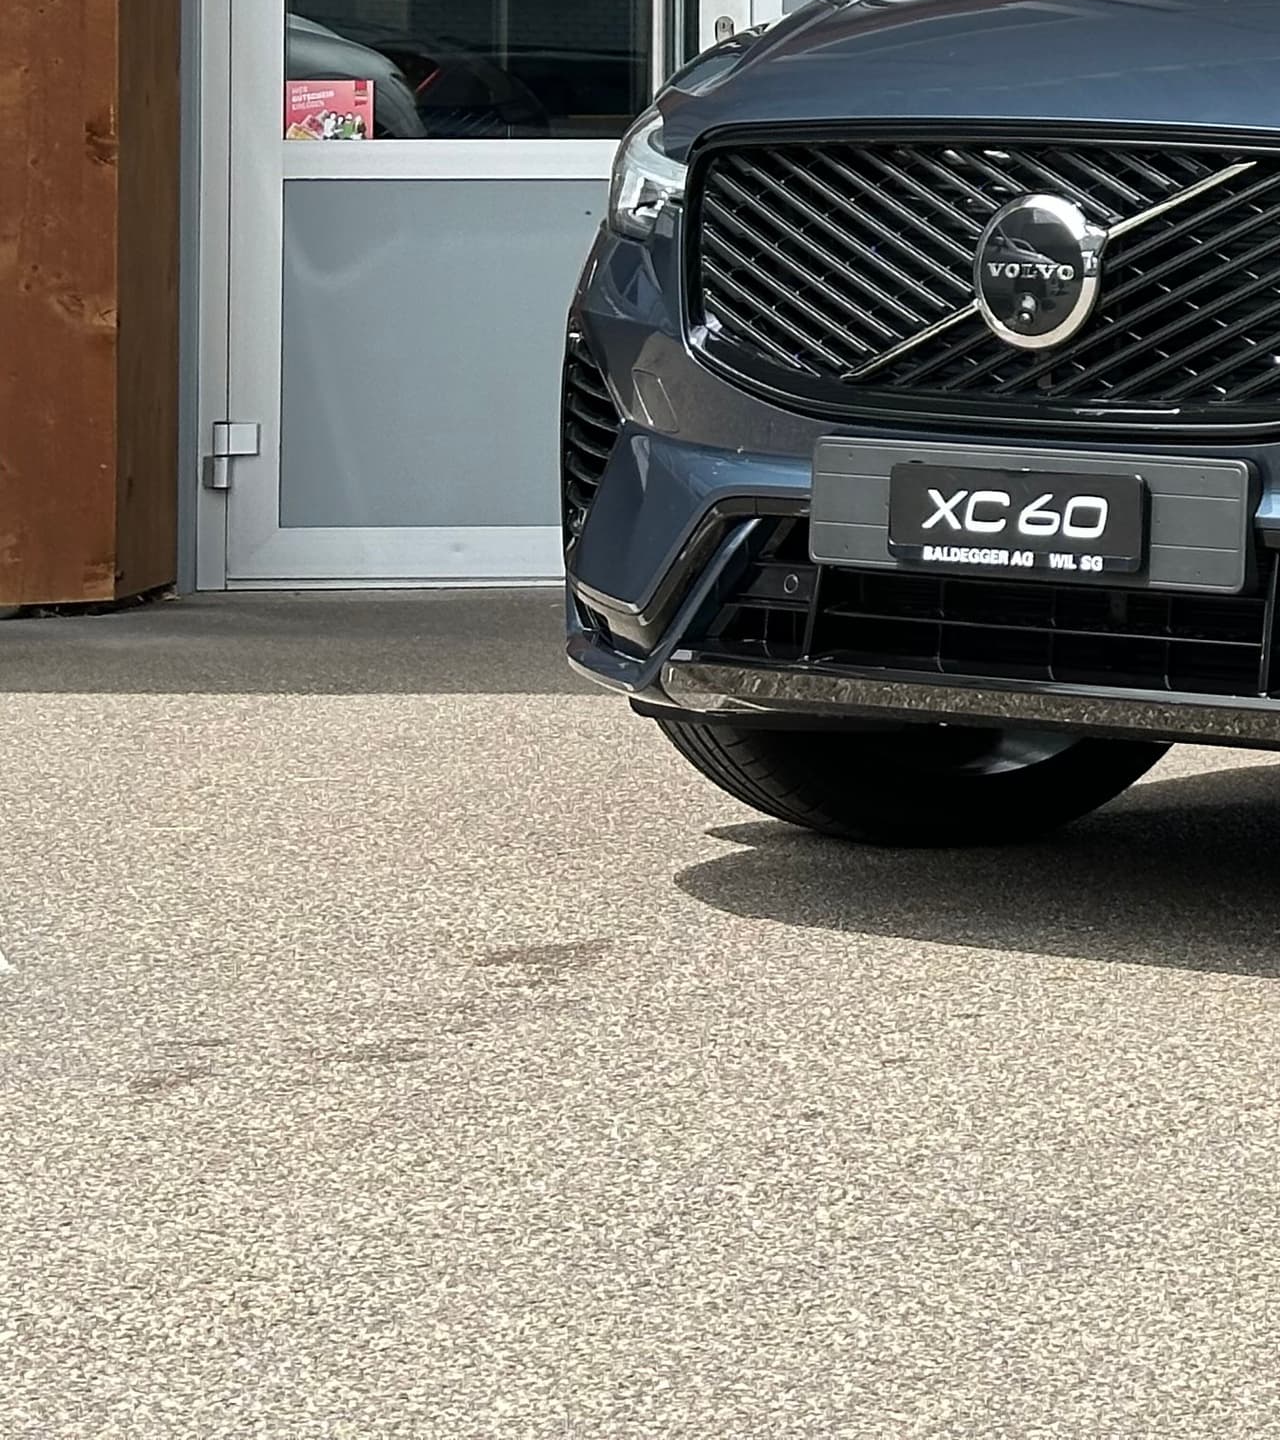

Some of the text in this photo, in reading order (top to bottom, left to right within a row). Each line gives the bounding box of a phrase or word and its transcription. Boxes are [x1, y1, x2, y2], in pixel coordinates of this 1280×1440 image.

[987, 262, 1075, 281] VOLVO
[922, 545, 1104, 572] BALDEGGER AG WIL SG
